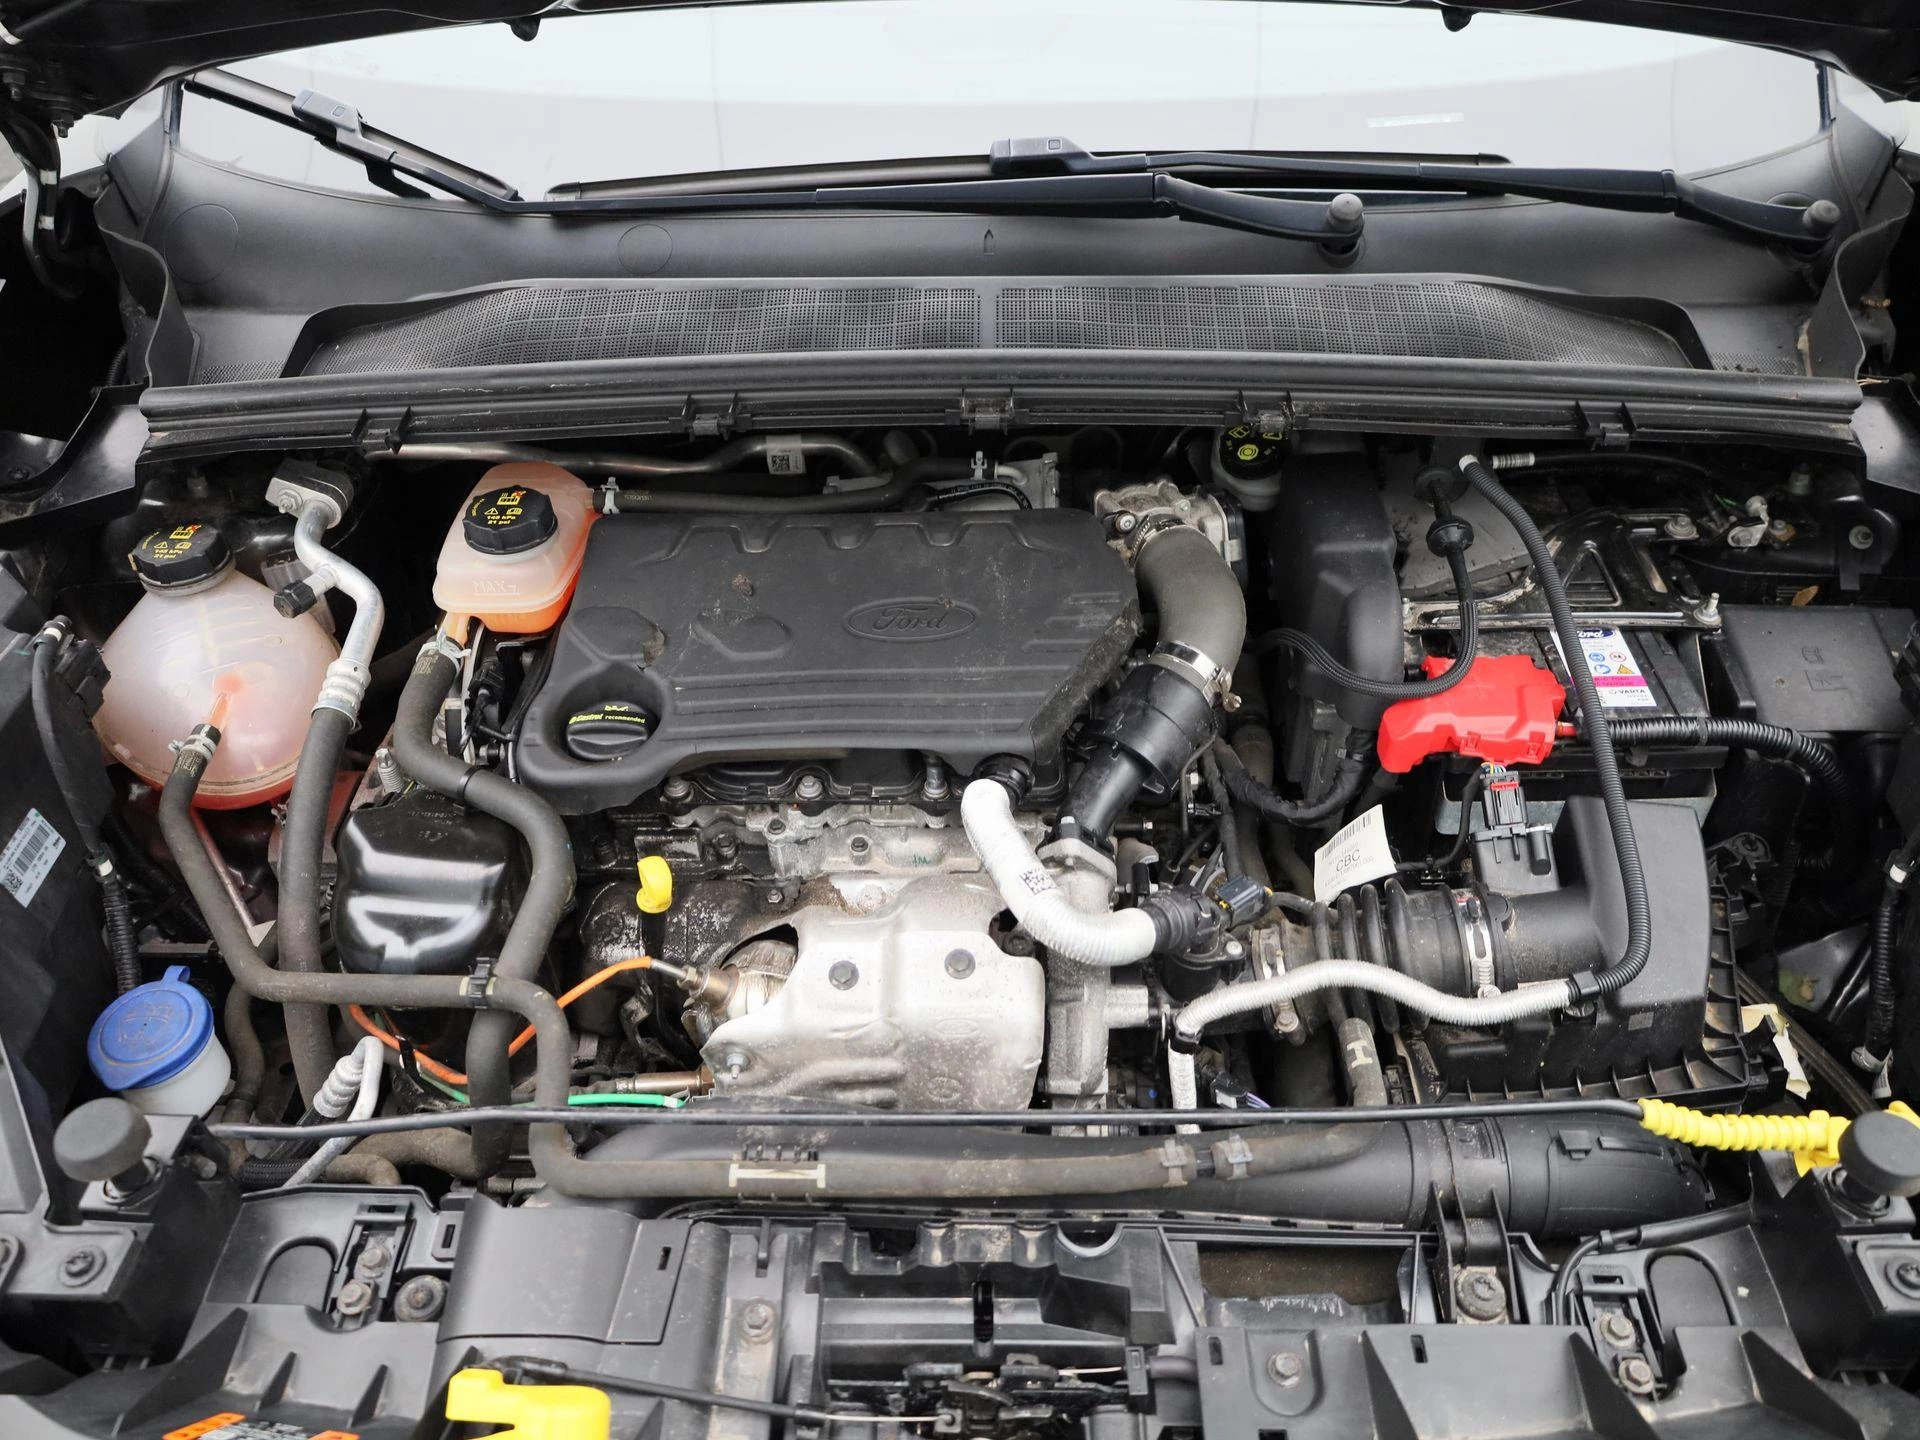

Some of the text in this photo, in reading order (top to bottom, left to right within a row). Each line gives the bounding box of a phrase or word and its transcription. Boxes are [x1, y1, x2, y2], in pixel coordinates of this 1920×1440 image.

[872, 607, 949, 631] Ford
[576, 713, 646, 724] Castrol recommended
[1336, 849, 1361, 872] CBC
